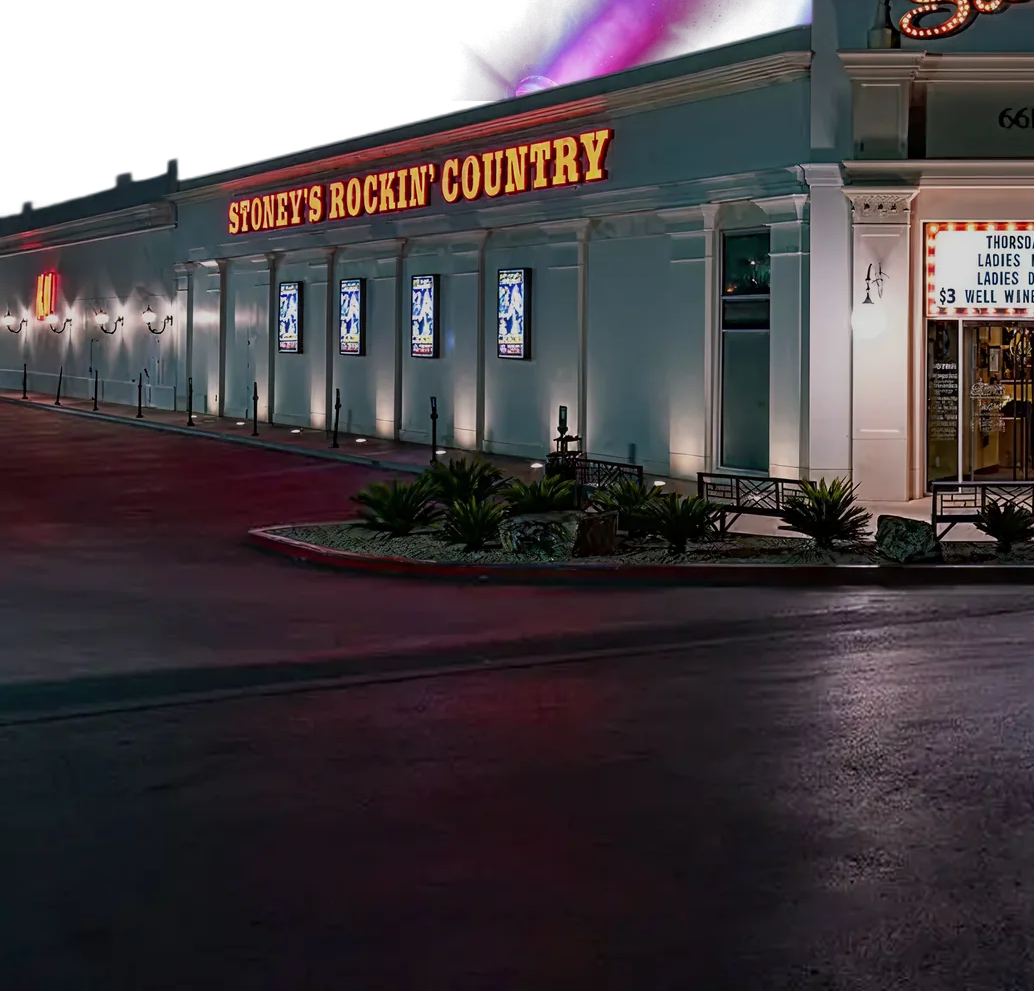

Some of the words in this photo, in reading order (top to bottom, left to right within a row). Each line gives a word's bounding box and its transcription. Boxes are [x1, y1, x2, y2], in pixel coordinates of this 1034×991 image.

[227, 183, 323, 235] STONEY'S
[327, 163, 436, 220] ROCKIN'
[440, 128, 612, 204] COUNTRY
[977, 253, 1021, 268] LADIES
[977, 271, 1019, 286] LADIES
[939, 287, 956, 306] $3
[964, 289, 998, 304] WELL
